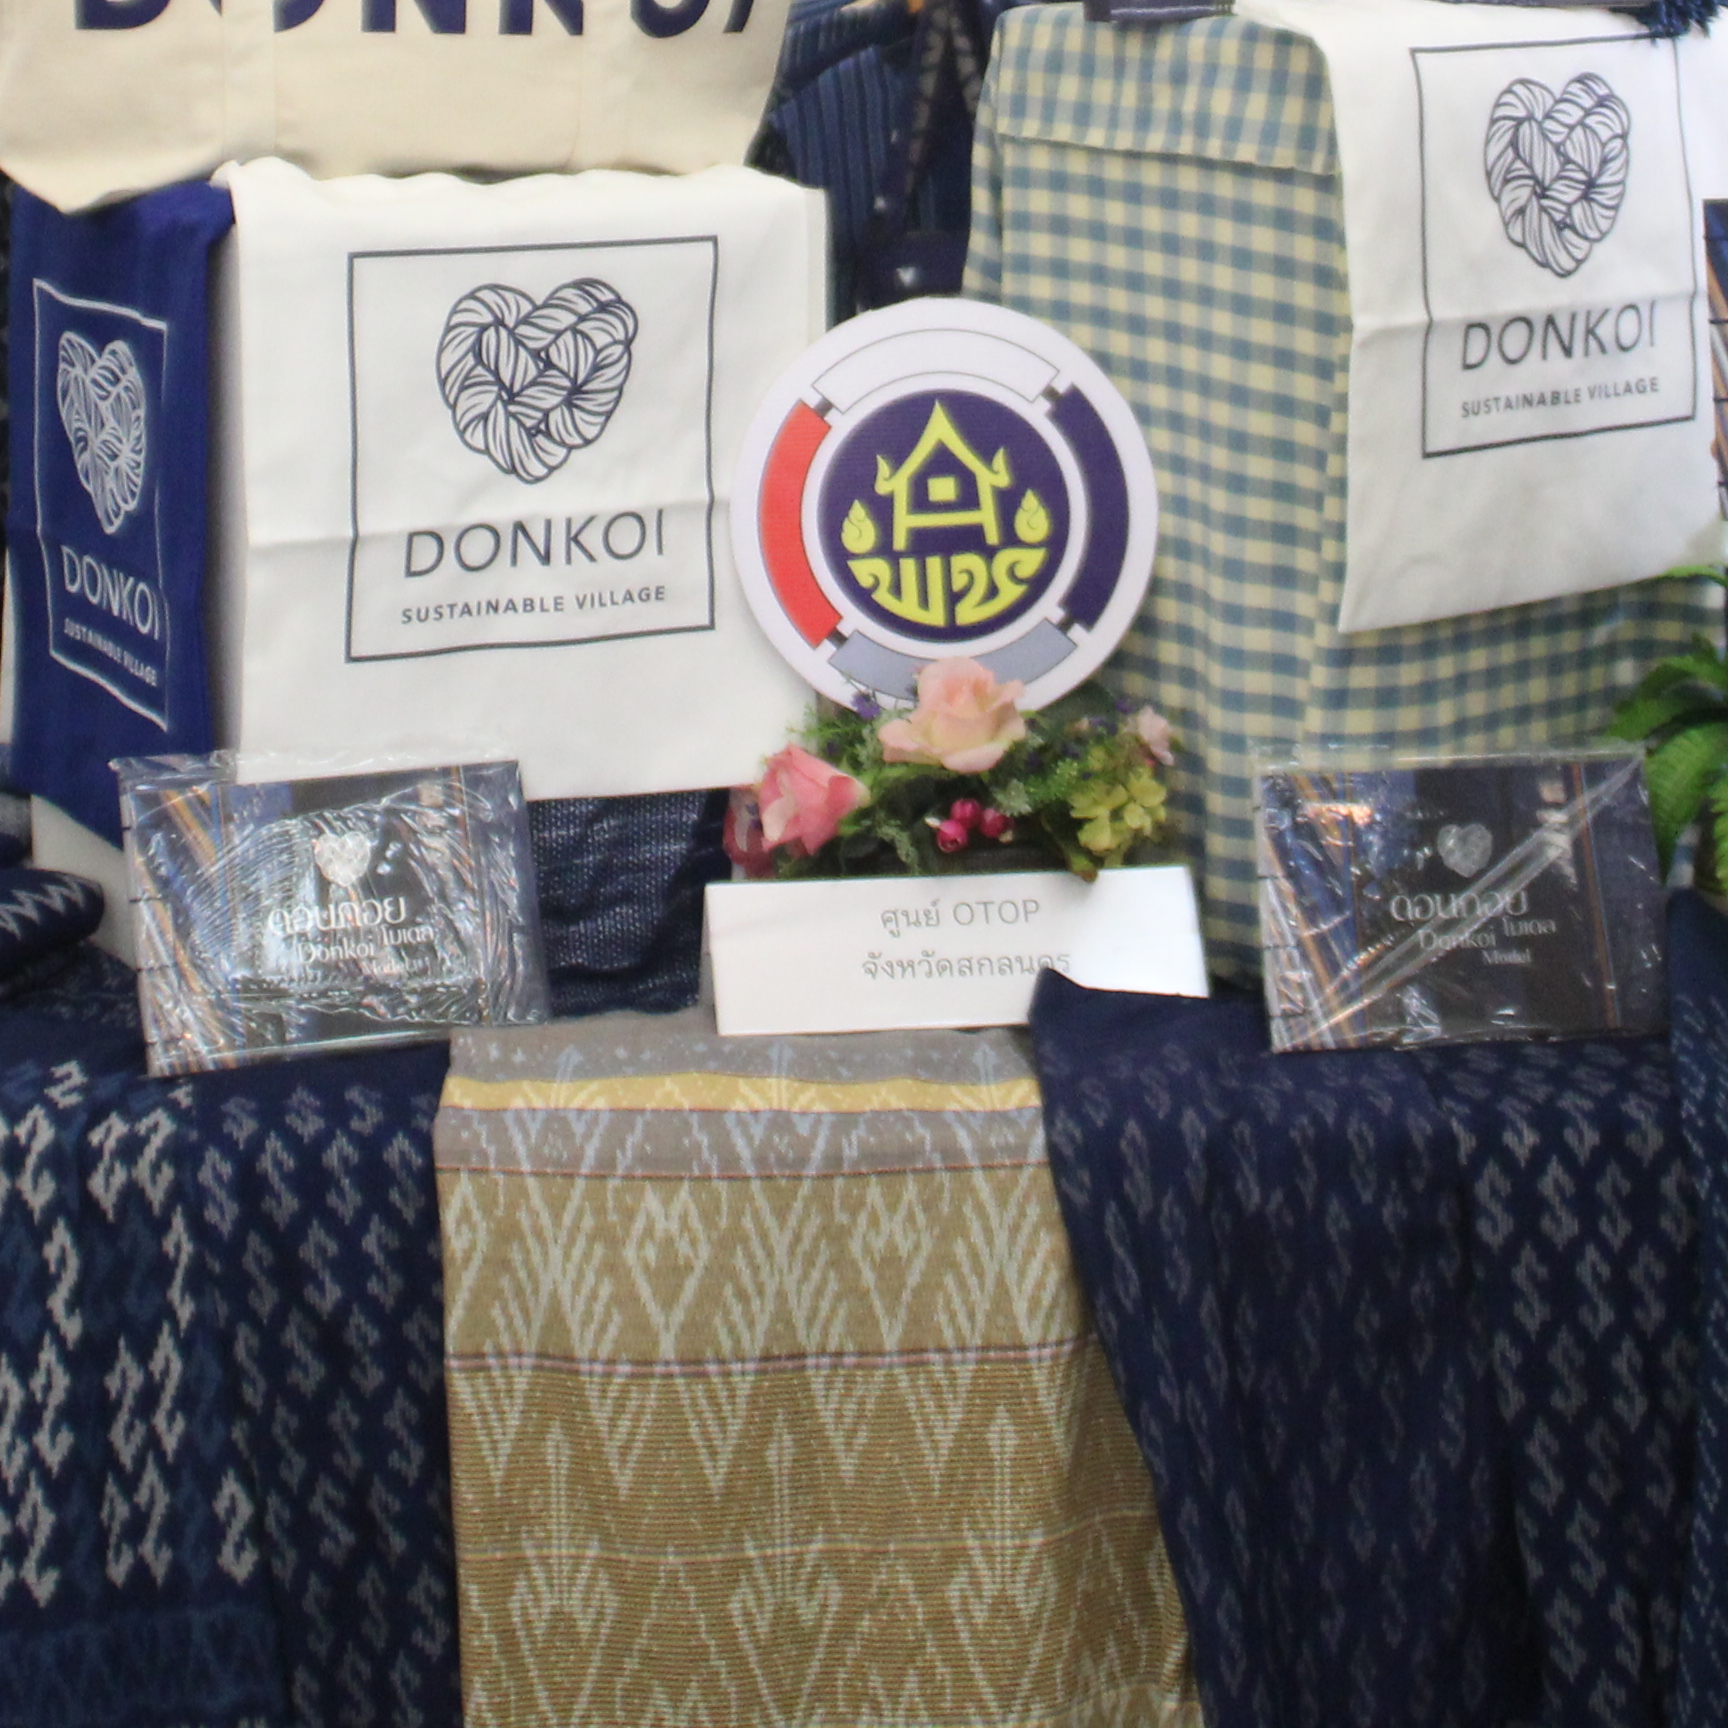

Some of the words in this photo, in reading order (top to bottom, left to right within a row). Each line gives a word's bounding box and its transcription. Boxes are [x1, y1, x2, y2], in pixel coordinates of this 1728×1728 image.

[1461, 299, 1658, 371] DONKOI
[1461, 387, 1582, 419] SUSTAINABLE
[1587, 376, 1660, 402] VILLAGE
[403, 508, 665, 579] DONKOI
[60, 544, 159, 641] DONKOI
[401, 594, 565, 626] SUSTAINABLE
[574, 584, 667, 610] VILLAGE
[267, 895, 407, 937] ดอนกอย
[380, 924, 434, 947] โมเดล
[879, 898, 941, 938] ศูนย์
[952, 898, 1041, 926] OTOP
[298, 934, 375, 964] Donkoi
[1481, 948, 1533, 965] Model
